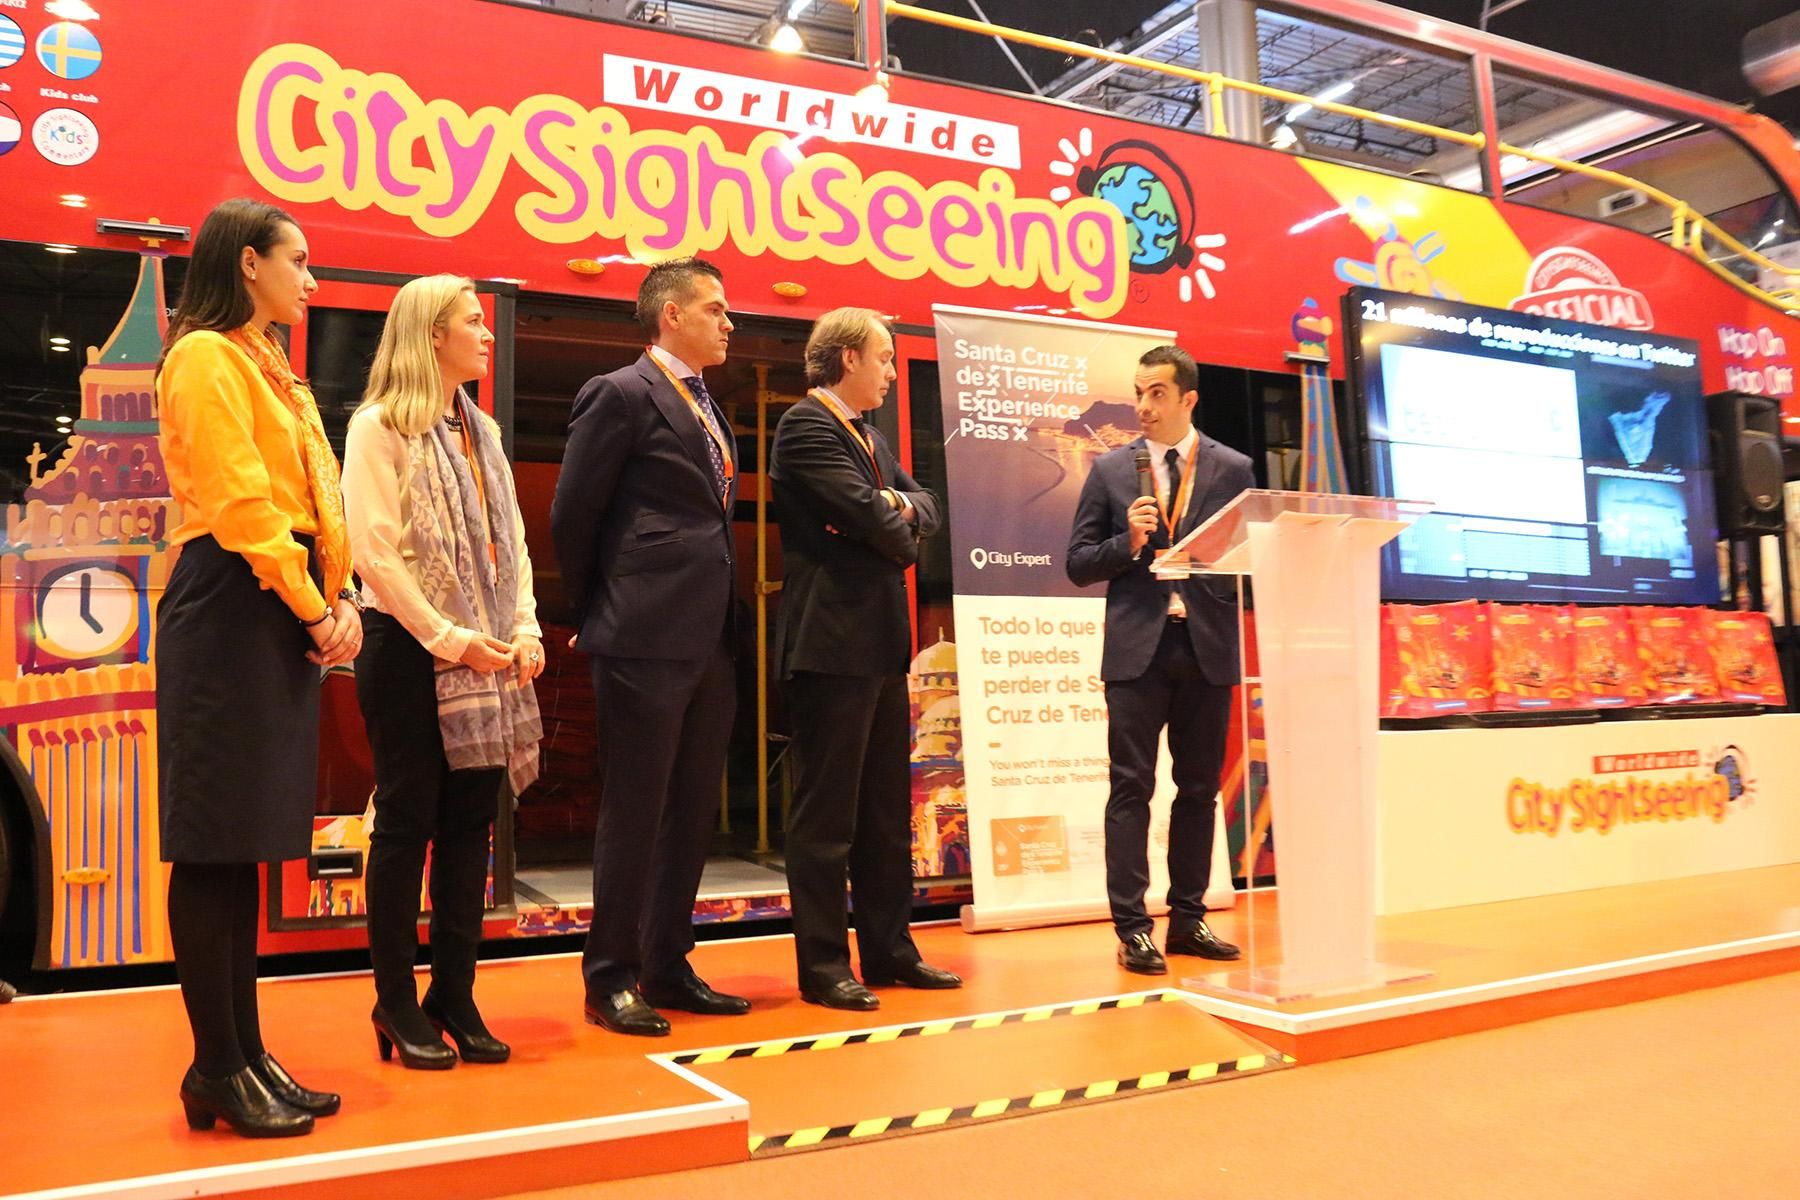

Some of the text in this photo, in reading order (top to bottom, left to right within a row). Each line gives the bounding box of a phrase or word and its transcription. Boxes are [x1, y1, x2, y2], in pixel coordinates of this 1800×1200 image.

[40, 87, 99, 104] Kids club
[632, 65, 996, 158] Worldwide
[239, 43, 1128, 318] City Sightseeing
[1360, 299, 1388, 322] 21
[1468, 317, 1494, 338] de
[954, 338, 1017, 364] Santa
[1021, 346, 1070, 369] Cruz
[1717, 326, 1787, 360] Hop On
[956, 365, 985, 387] de
[1001, 366, 1089, 396] Tenerife
[958, 391, 1081, 420] Experience
[959, 417, 1009, 441] Pass
[988, 551, 1053, 567] City Expert
[978, 616, 1031, 635] Todo
[1034, 616, 1055, 635] lo
[1059, 621, 1097, 638] que
[981, 646, 1081, 668] te puedes
[983, 675, 1052, 698] perder
[1056, 675, 1082, 693] de
[986, 705, 1033, 724] Cruz
[1038, 704, 1065, 723] de
[990, 759, 1011, 770] You
[1013, 759, 1045, 769] won't
[1047, 759, 1072, 768] miss
[1074, 759, 1081, 767] a
[1600, 751, 1698, 773] Worldwide
[991, 776, 1022, 787] Santa
[1025, 774, 1052, 785] Cruz
[1053, 775, 1066, 784] de
[1506, 771, 1729, 837] City Sightseeing
